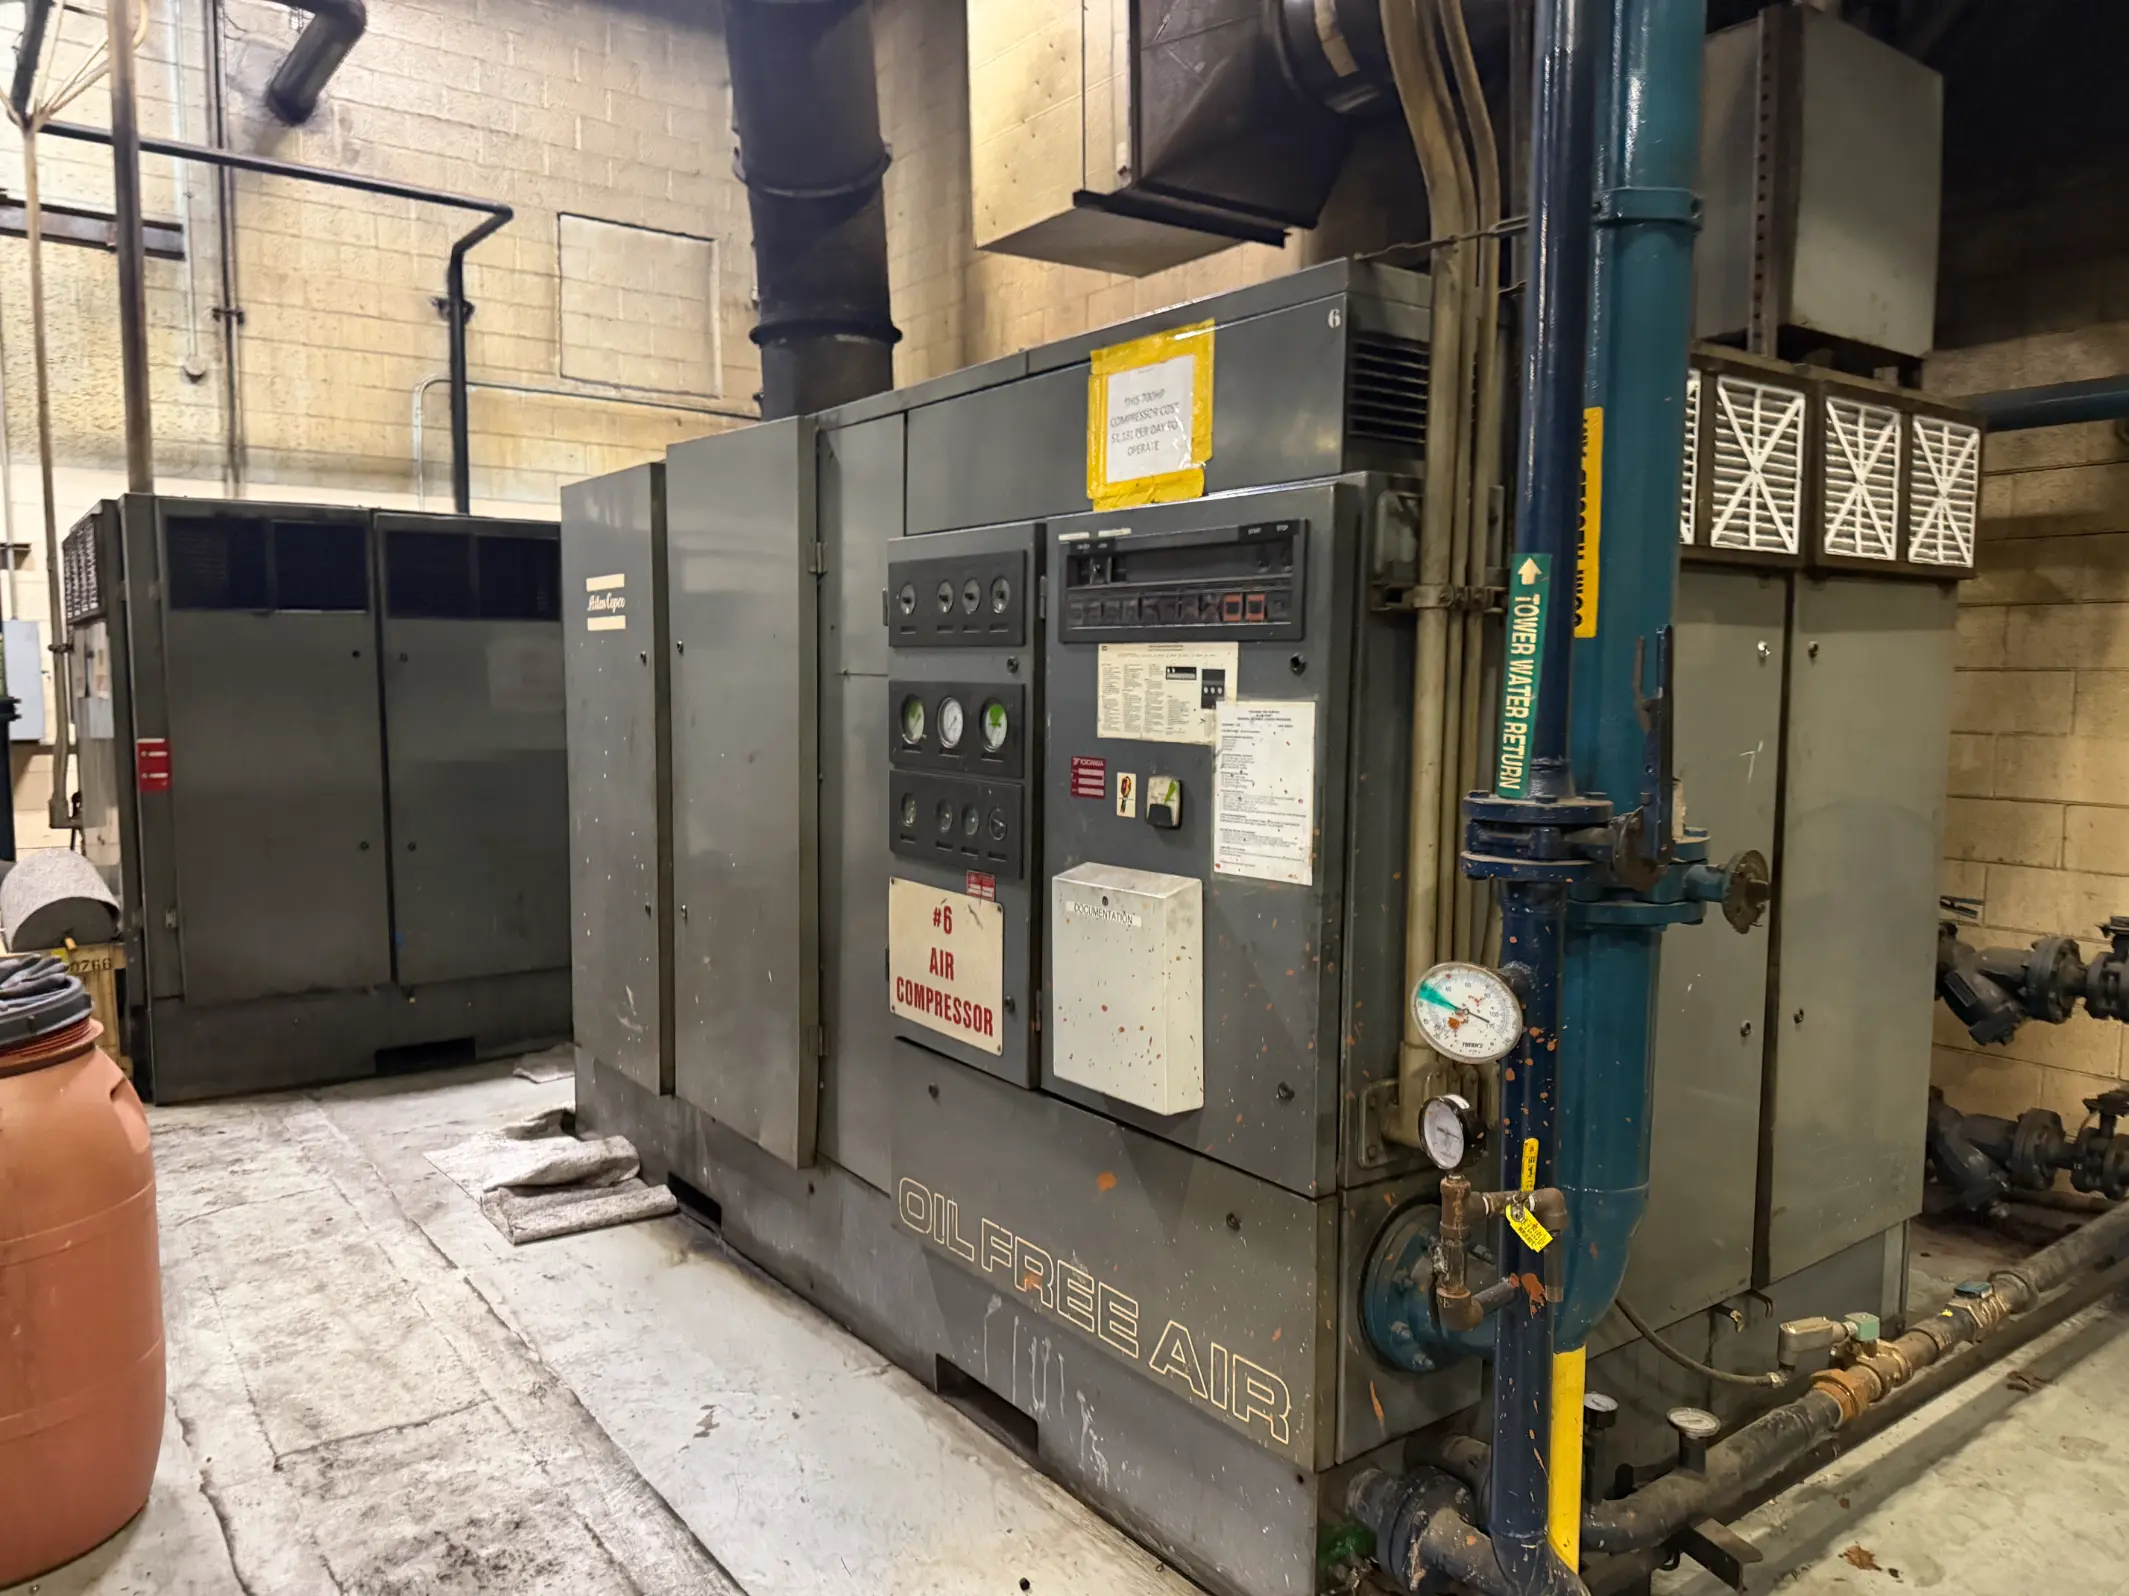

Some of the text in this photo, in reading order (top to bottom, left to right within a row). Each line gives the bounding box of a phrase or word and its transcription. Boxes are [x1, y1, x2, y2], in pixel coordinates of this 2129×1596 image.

[1327, 307, 1341, 329] 6
[1109, 402, 1180, 428] COMPRESSOR COST
[1135, 426, 1149, 439] PER
[1150, 422, 1166, 435] DAY
[1167, 420, 1179, 431] TO
[1127, 440, 1160, 456] OPERATE
[1498, 593, 1541, 791] TOWER WATER RETURN
[932, 905, 953, 935] #6
[1073, 902, 1134, 925] DOCUMENTATION
[929, 947, 955, 981] AIR
[896, 976, 994, 1037] COMPRESSOR
[898, 1176, 1292, 1445] OIL FREE AIR
